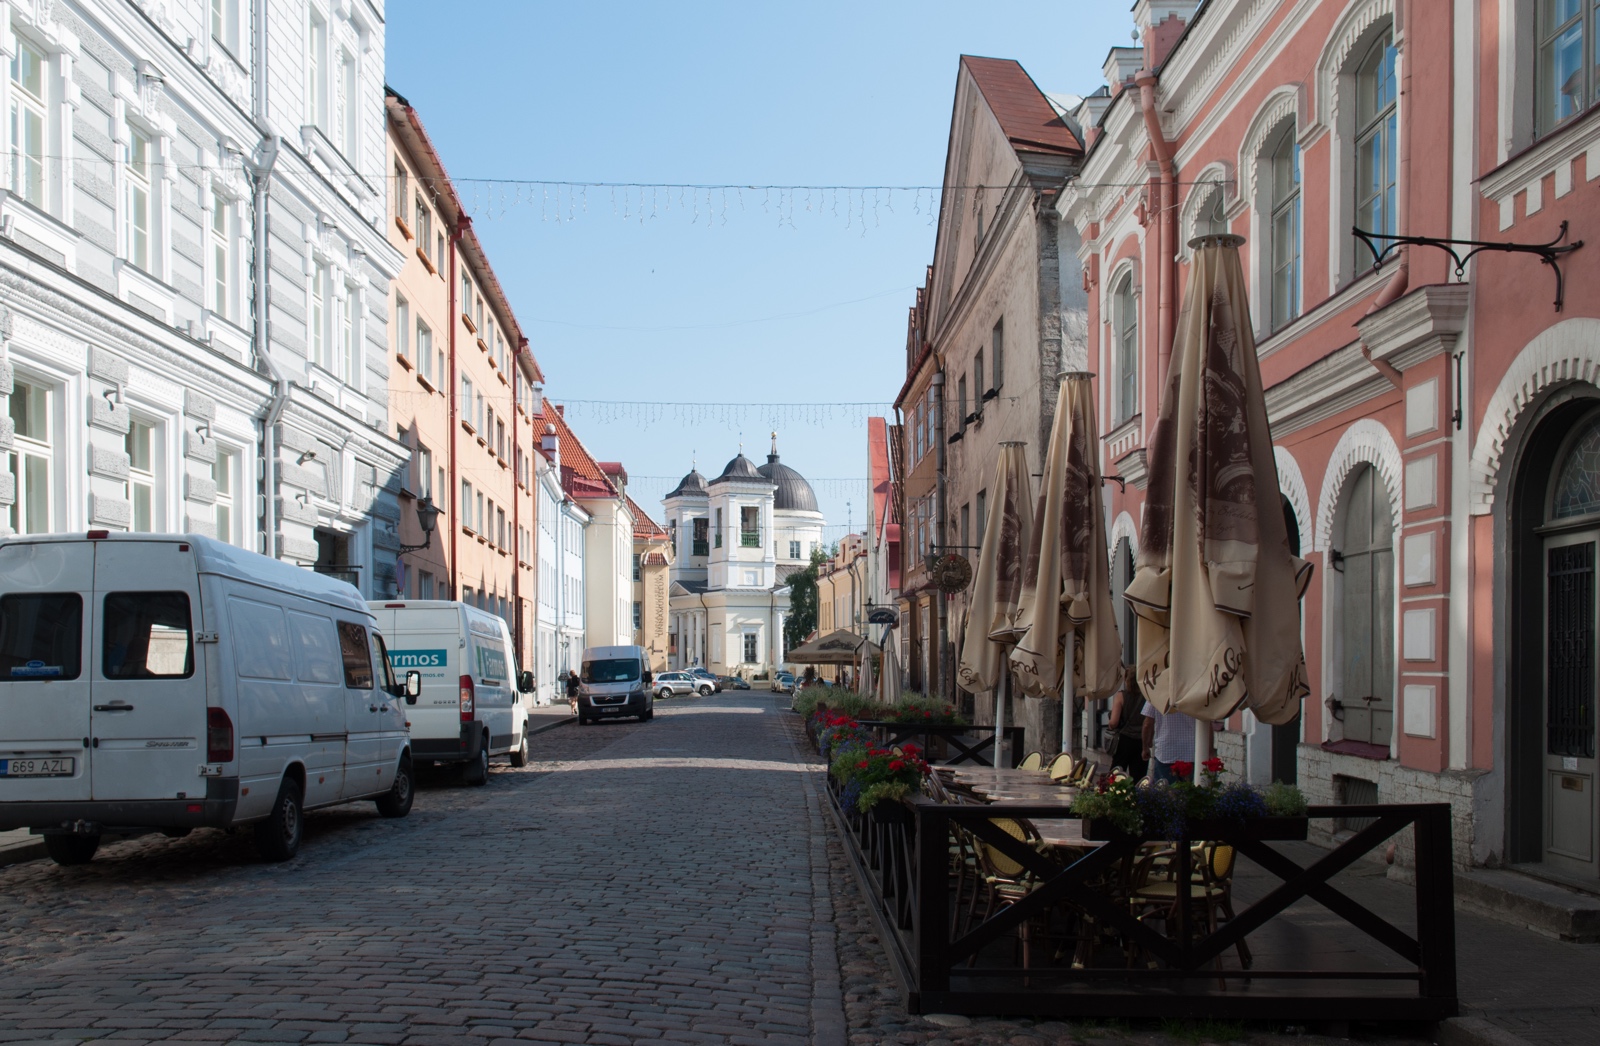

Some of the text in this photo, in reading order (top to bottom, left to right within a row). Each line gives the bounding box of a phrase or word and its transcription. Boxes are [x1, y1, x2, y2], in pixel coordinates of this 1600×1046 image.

[485, 651, 505, 677] Farmos
[12, 761, 35, 773] 669
[40, 760, 67, 772] AZL
